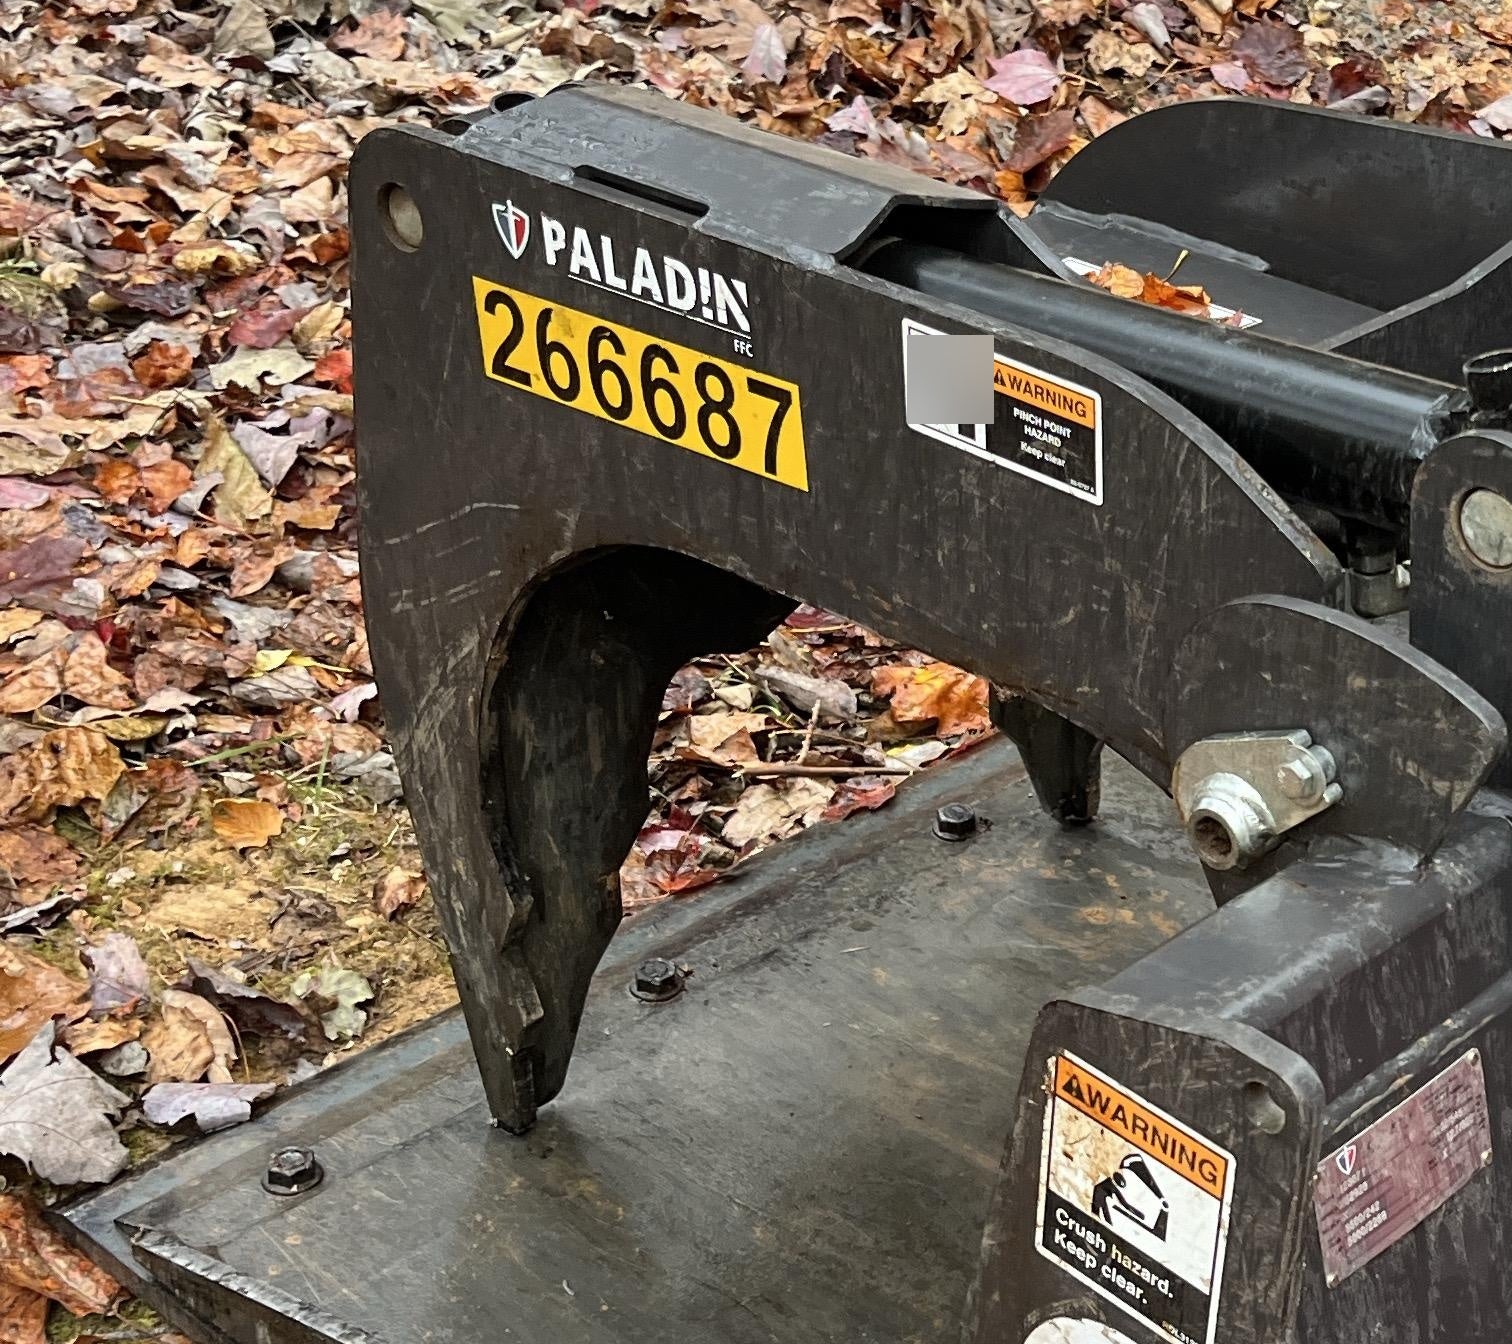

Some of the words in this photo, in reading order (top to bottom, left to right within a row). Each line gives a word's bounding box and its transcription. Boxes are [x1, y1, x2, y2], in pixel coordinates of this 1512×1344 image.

[540, 213, 751, 333] PALADIN
[734, 339, 754, 358] FFC
[483, 289, 793, 477] 266687
[1006, 372, 1087, 418] WARNING
[1013, 407, 1043, 429] PINCH
[1043, 418, 1072, 439] POINT
[1020, 440, 1043, 460] Keep
[1023, 425, 1062, 448] HAZARD
[1085, 1083, 1218, 1187] WARNING
[1053, 1227, 1098, 1269] Keep
[1100, 1262, 1148, 1305] clear.
[1055, 1207, 1107, 1254] Crush
[1110, 1242, 1175, 1299] hazard.
